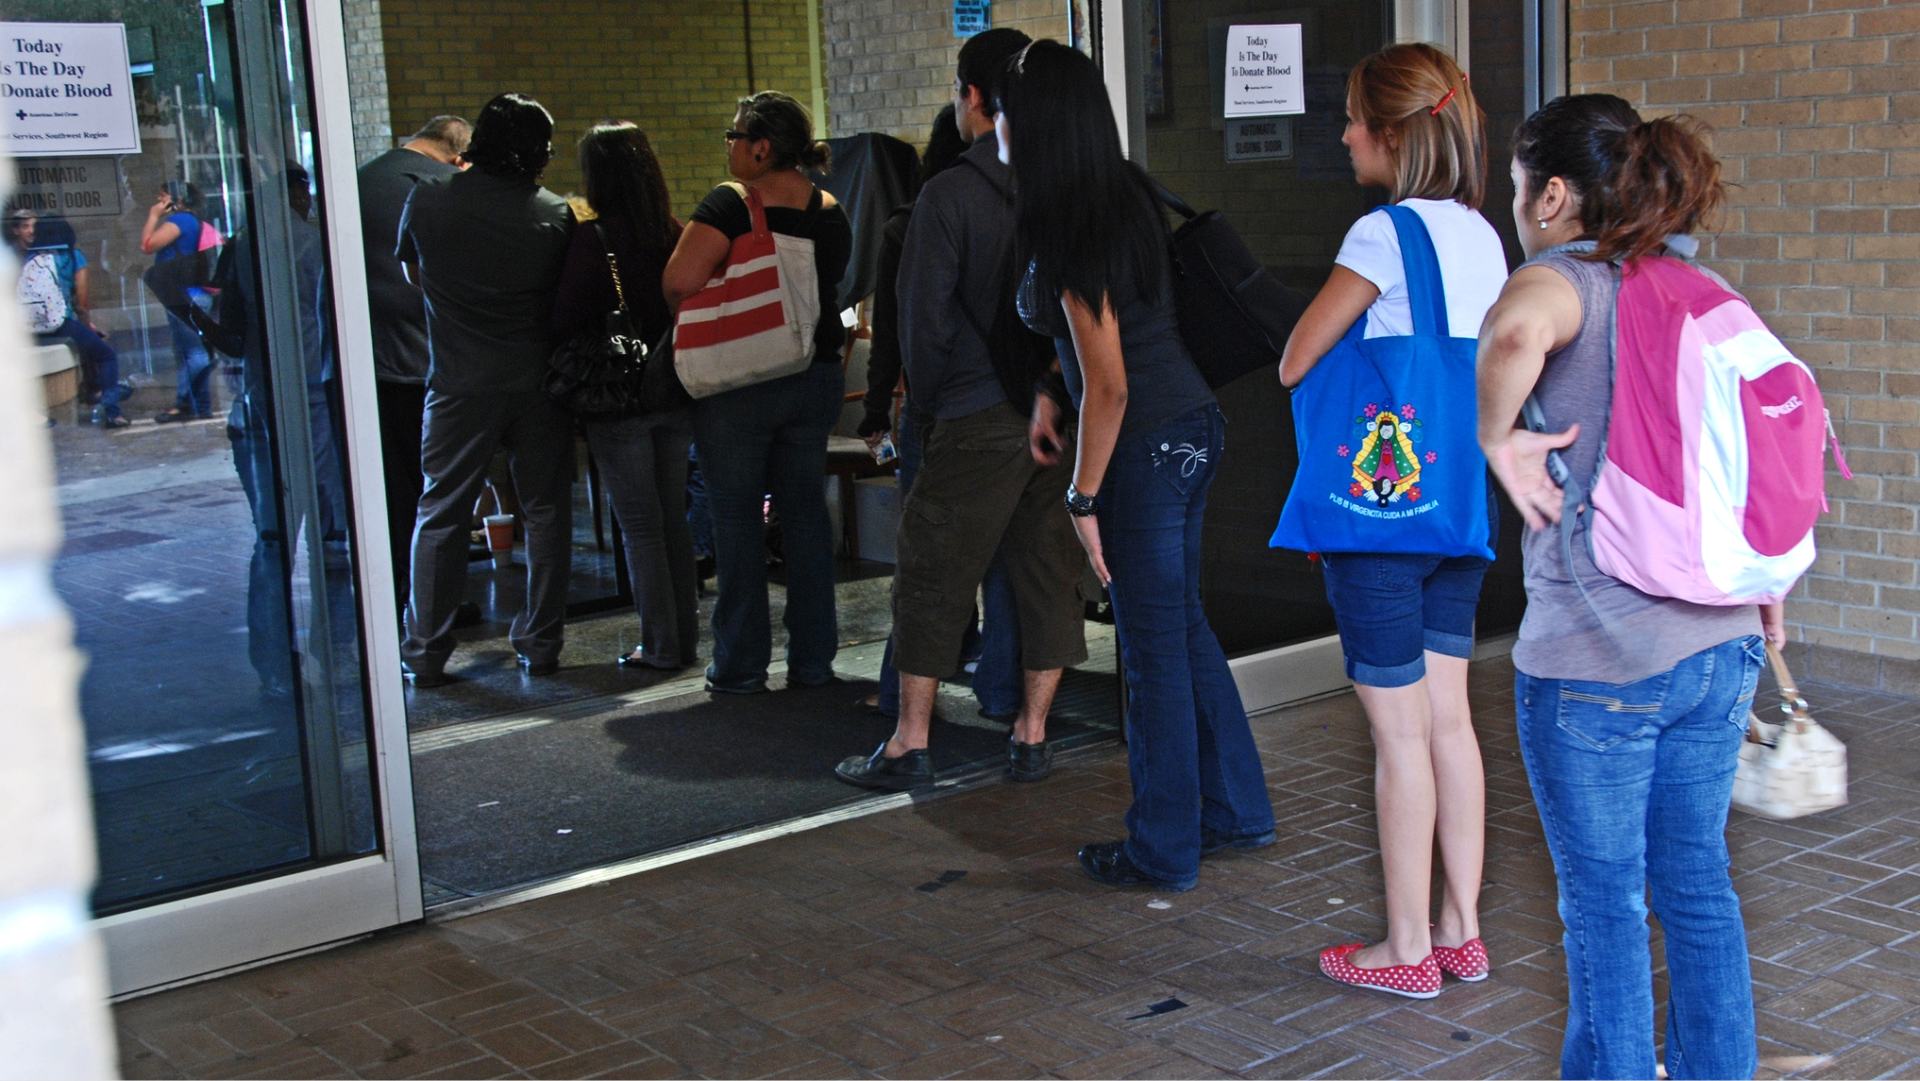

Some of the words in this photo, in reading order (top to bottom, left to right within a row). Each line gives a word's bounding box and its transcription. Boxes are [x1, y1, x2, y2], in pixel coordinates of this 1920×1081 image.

[13, 38, 63, 56] Today
[1246, 36, 1268, 48] Today
[1239, 51, 1245, 61] Is
[1246, 51, 1261, 61] The
[1262, 50, 1278, 63] Day
[15, 60, 48, 75] The
[52, 60, 86, 79] Day
[1231, 66, 1238, 76] To
[1239, 66, 1265, 76] Donate
[1266, 65, 1291, 76] Blood
[1, 83, 59, 98] Donate
[64, 83, 113, 98] Blood
[83, 131, 109, 140] Region
[17, 166, 88, 184] UTOMATIC
[64, 191, 102, 208] DOOR
